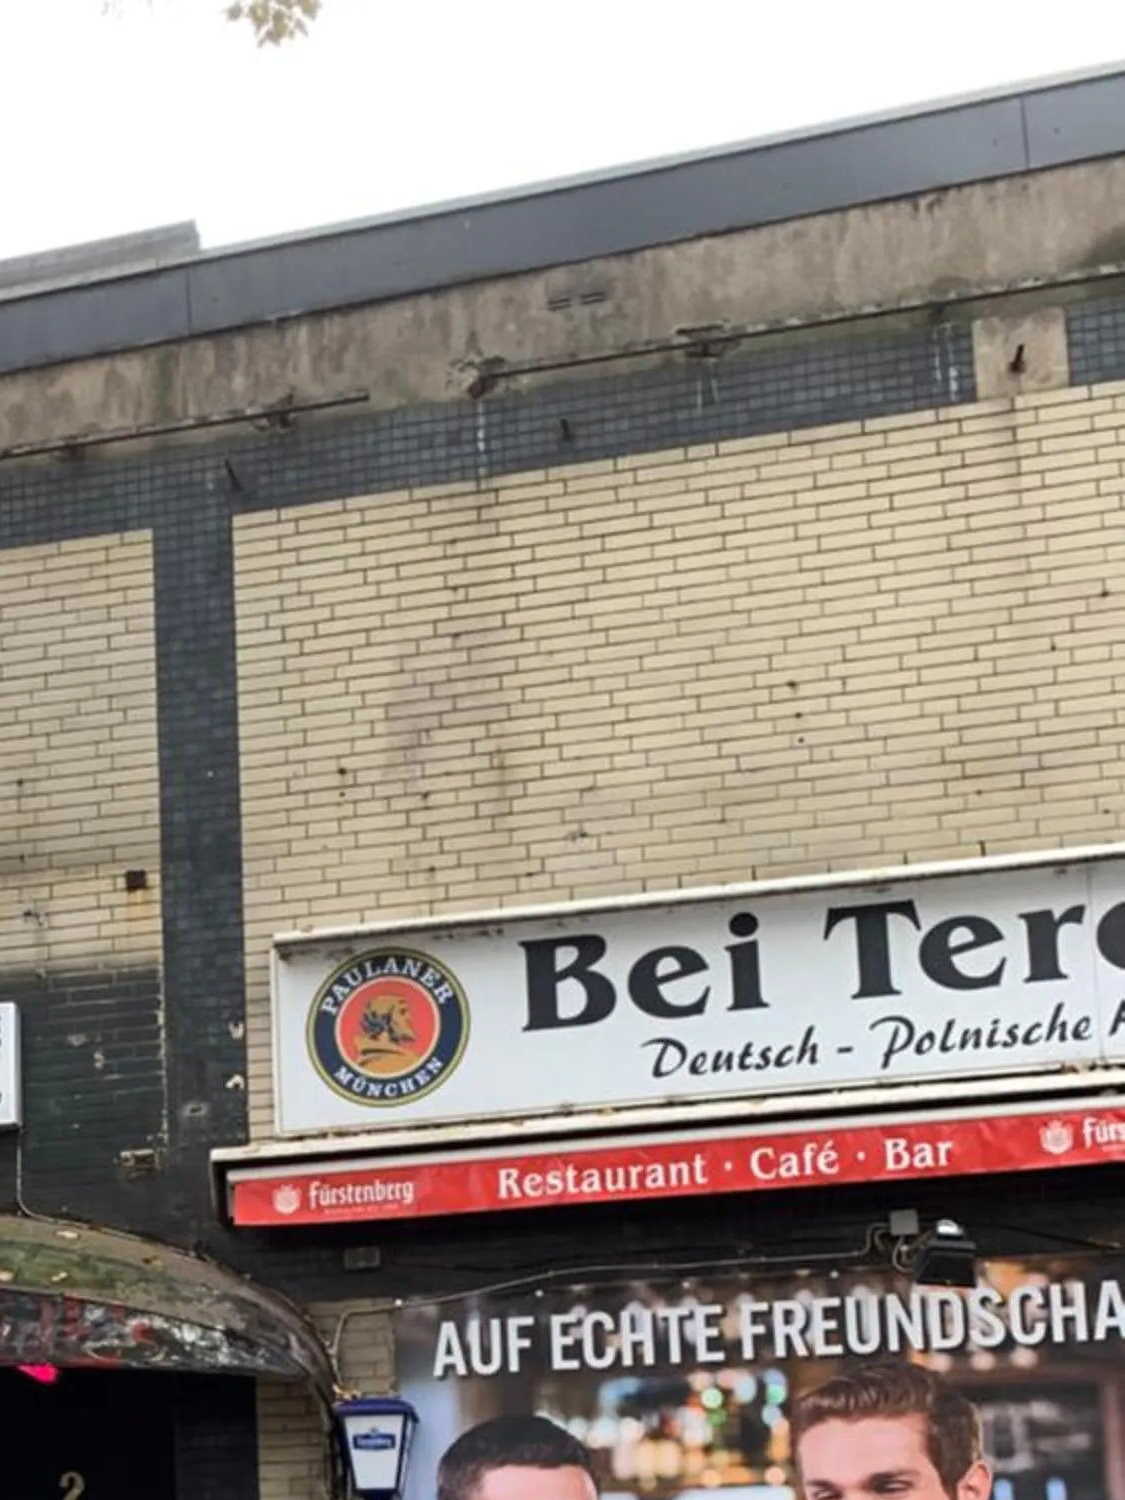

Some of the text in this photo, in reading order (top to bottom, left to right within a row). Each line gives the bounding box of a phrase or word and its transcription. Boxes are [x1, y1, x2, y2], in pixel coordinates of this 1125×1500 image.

[321, 956, 455, 1016] PAULANER
[517, 911, 771, 1032] Bei
[640, 1025, 820, 1079] Deutsch
[868, 1002, 1092, 1070] Polnische
[333, 1056, 444, 1098] MÜNCHEN
[498, 1137, 954, 1200] Restaurant Café Bar
[433, 1279, 1125, 1378] AUF ECHTE FREUNDSCHA
